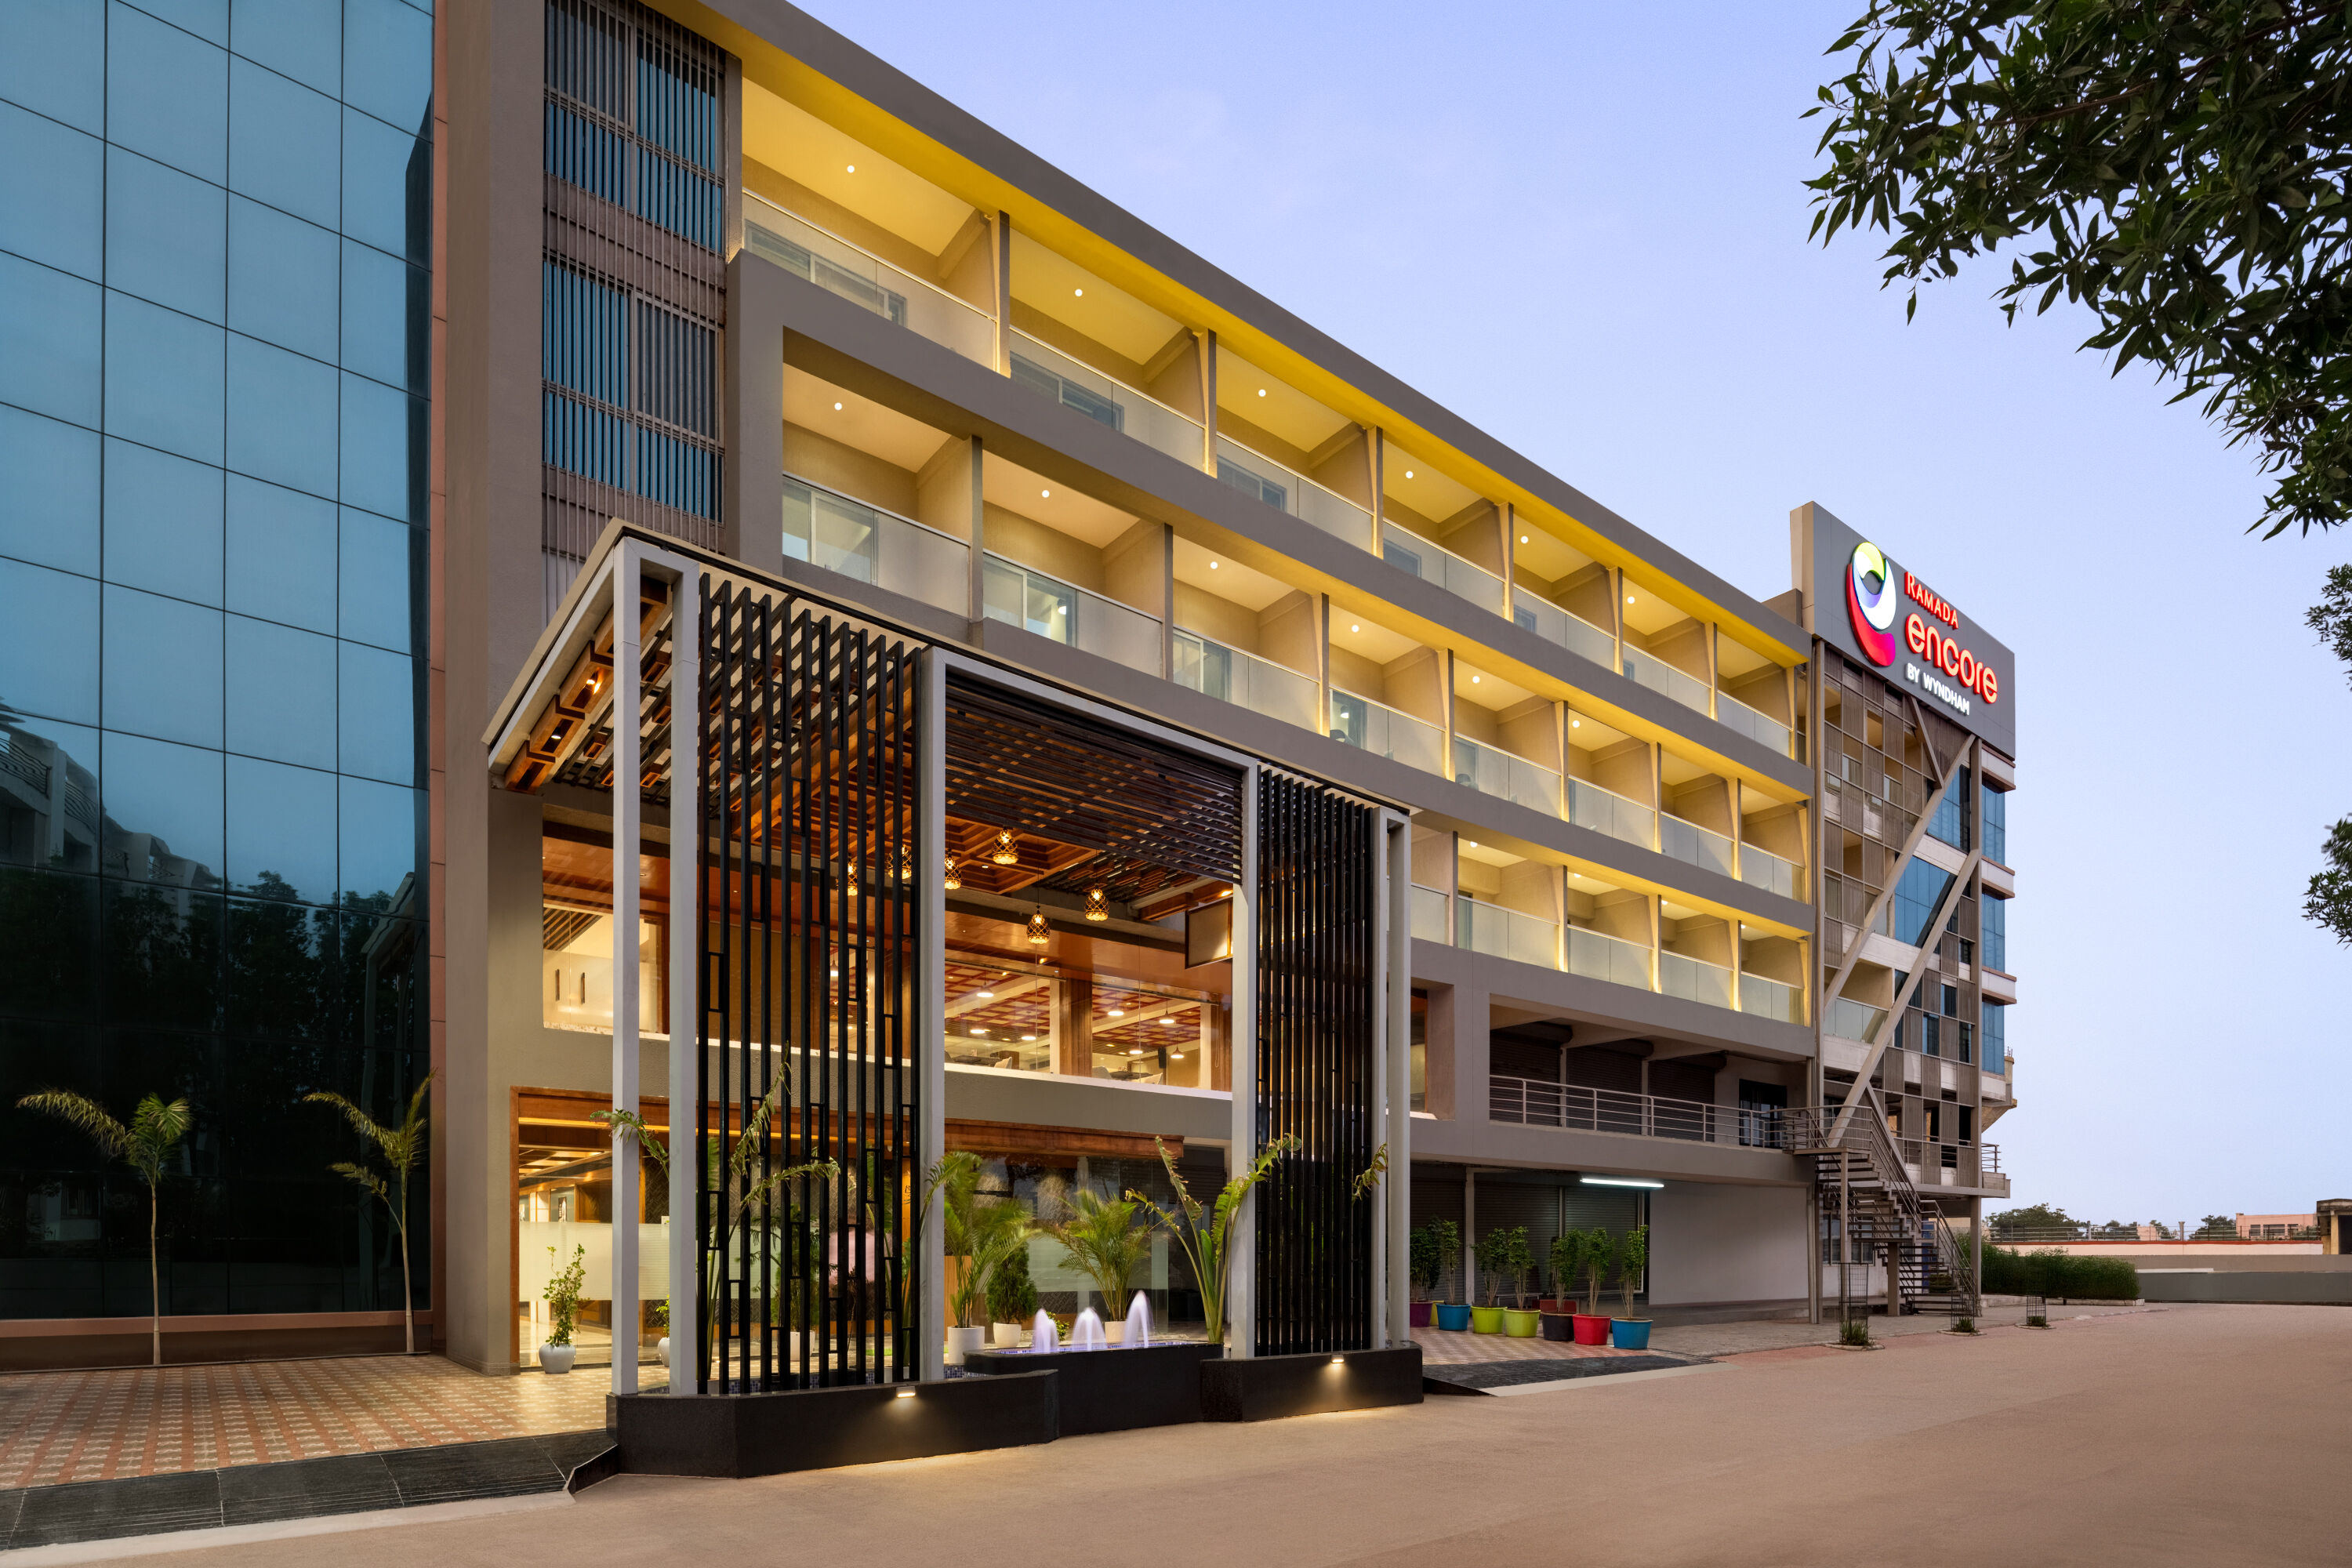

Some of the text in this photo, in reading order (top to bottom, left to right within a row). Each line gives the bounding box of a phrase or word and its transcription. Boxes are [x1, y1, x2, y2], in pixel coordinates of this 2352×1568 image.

[1904, 571, 1958, 629] RAMADA
[1905, 613, 1998, 703] encore
[1907, 662, 1969, 715] BY WYNDHAM
